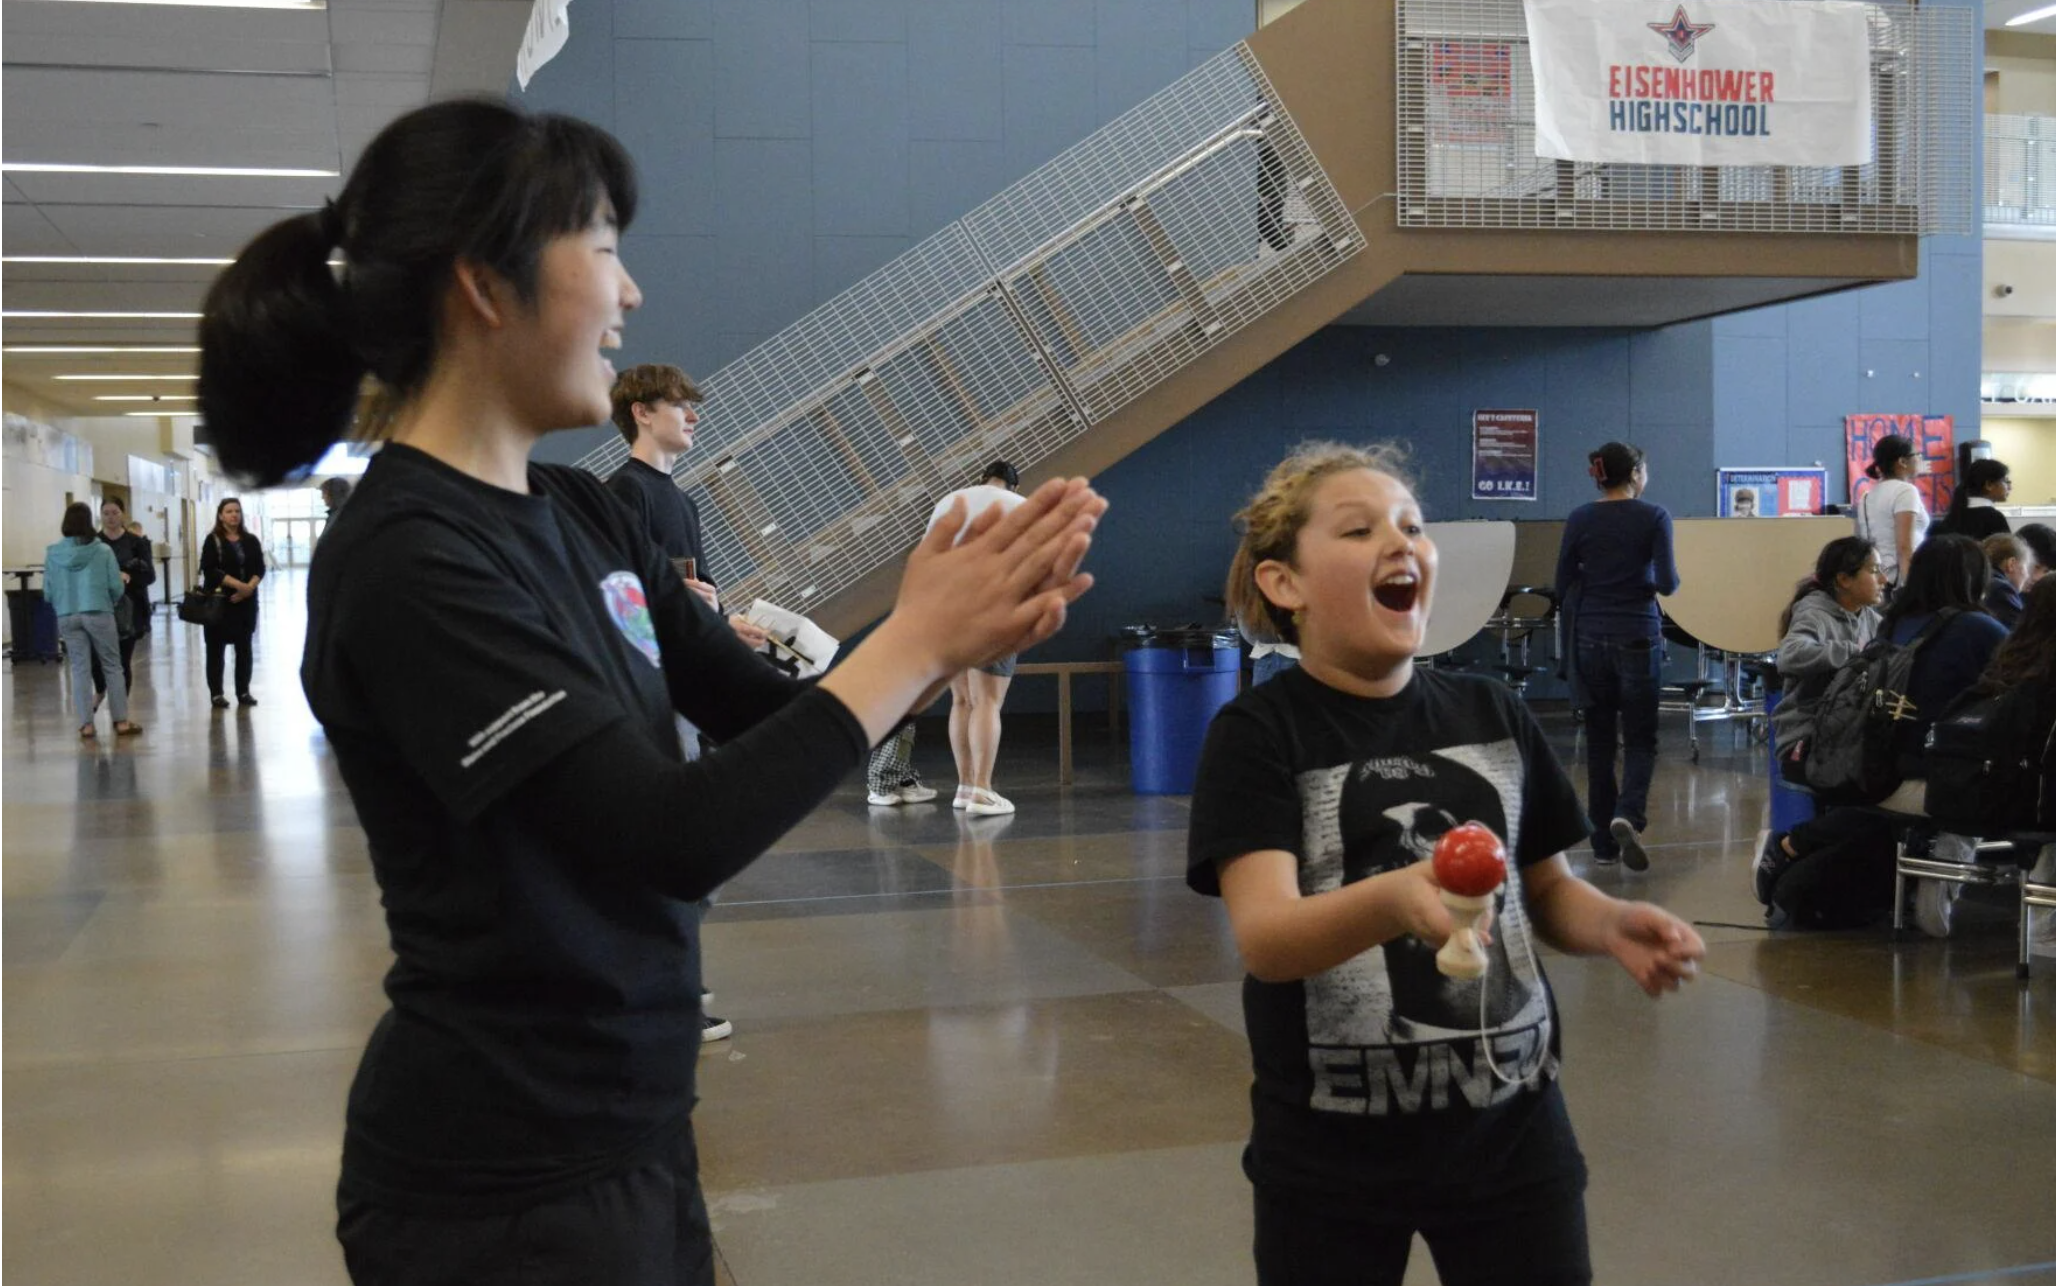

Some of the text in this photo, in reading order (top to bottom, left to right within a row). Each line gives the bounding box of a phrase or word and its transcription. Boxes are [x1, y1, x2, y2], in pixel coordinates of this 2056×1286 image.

[1609, 65, 1774, 103] EISENHOWER
[1610, 101, 1770, 136] HIGHSCHOOL
[1478, 481, 1494, 491] GO
